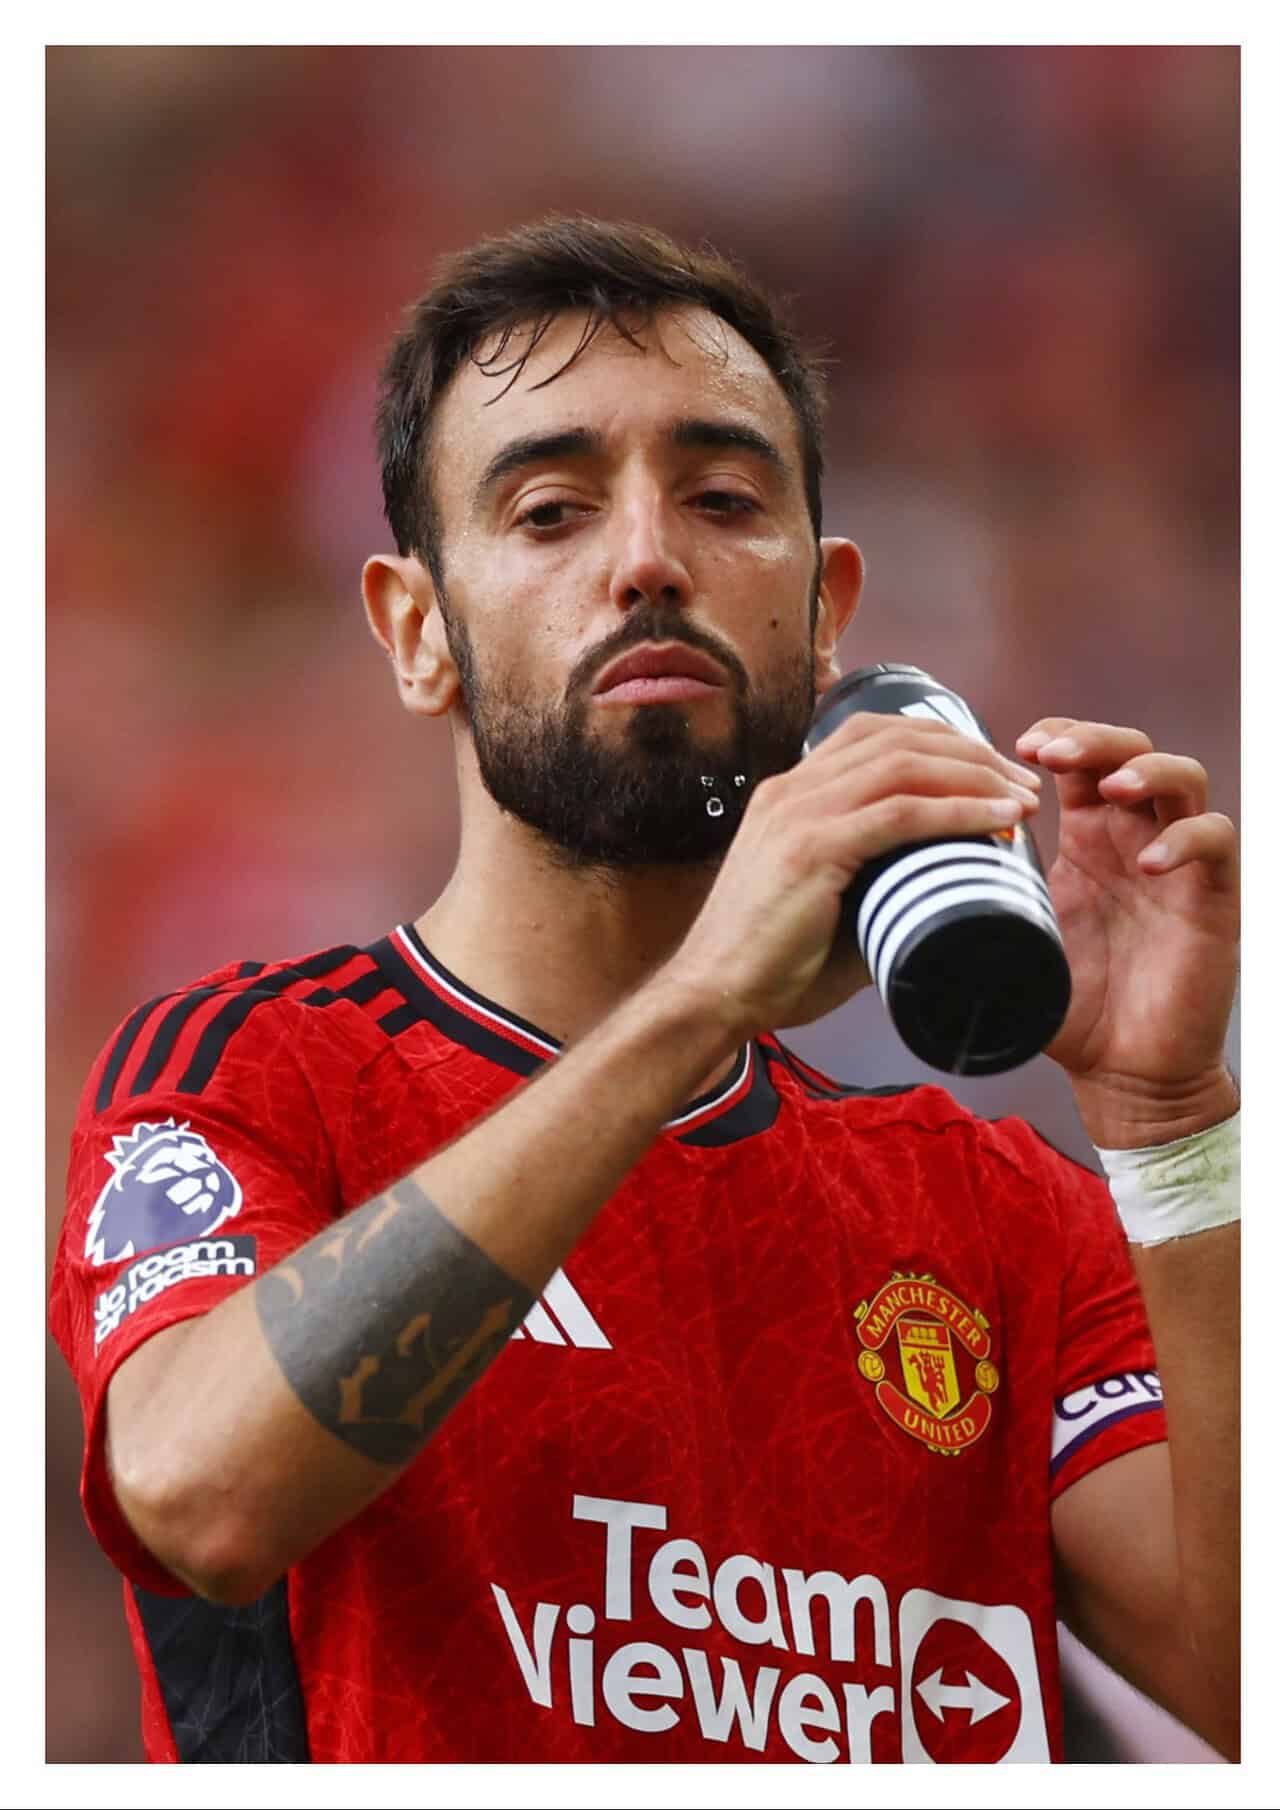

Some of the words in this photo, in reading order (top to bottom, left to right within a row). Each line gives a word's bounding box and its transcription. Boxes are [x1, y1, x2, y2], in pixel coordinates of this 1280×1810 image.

[128, 1240, 235, 1292] room
[128, 1256, 255, 1314] racism
[866, 1286, 982, 1348] MANCHESTER
[903, 1413, 976, 1445] UNITED
[572, 1493, 893, 1668] Team
[490, 1581, 896, 1764] Viewer
